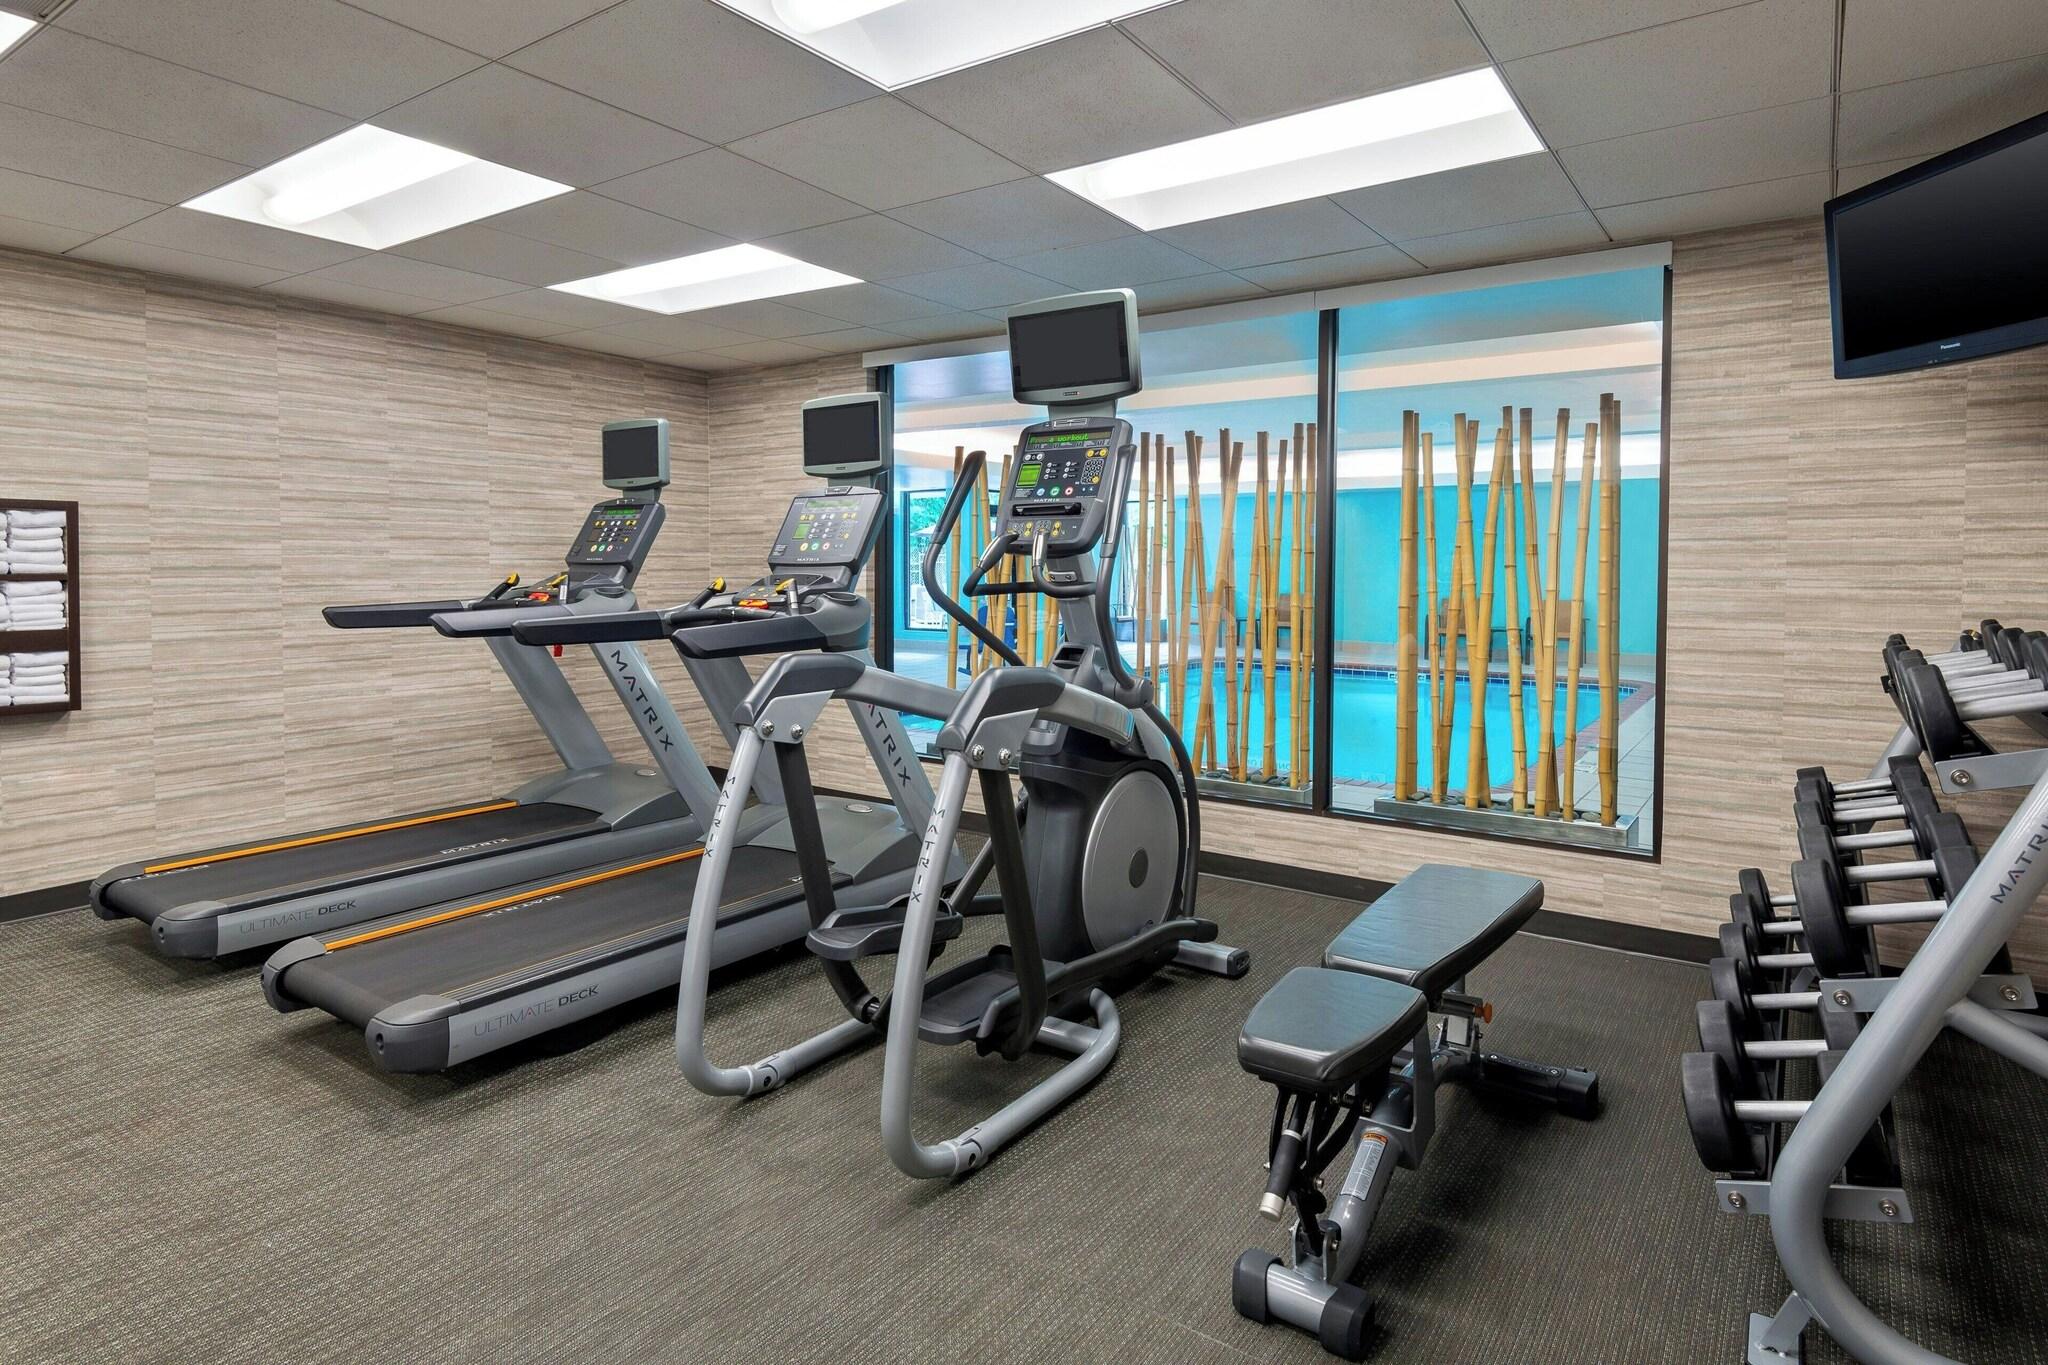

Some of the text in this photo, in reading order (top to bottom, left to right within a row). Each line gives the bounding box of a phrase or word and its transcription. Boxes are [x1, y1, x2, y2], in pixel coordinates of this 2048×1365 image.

[610, 649, 674, 752] MATRIX
[703, 776, 737, 858] MATRIX
[911, 807, 946, 903] MATRIX
[1989, 814, 2048, 904] MATRI
[239, 899, 357, 934] ULTIMATE DECK
[473, 982, 600, 1037] ULTIMATE DECK
